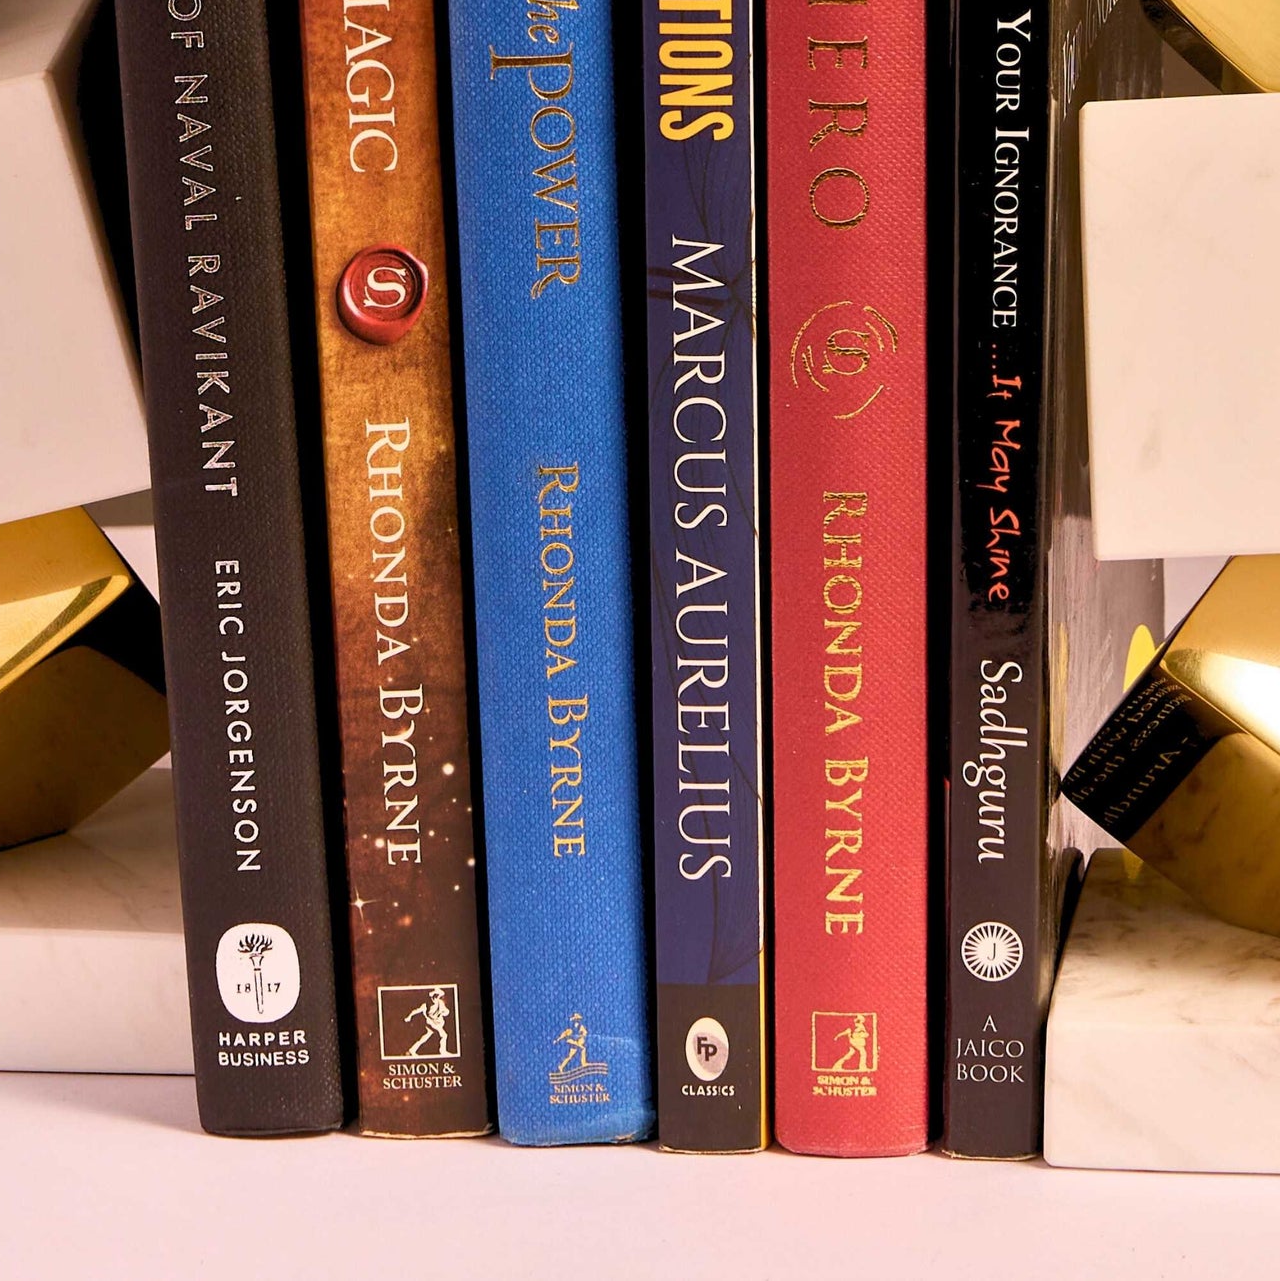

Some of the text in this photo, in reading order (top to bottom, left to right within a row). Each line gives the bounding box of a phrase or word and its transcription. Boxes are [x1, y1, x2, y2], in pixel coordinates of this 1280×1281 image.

[994, 8, 1032, 114] YOUR
[173, 74, 218, 231] NAVAL
[488, 41, 581, 300] POWER
[992, 126, 1030, 330] IGNORANCE
[187, 253, 238, 497] RAVIKANT
[976, 419, 1021, 494] May
[671, 234, 732, 882] MARCUS AURELIUS
[987, 505, 1021, 603] Shine
[365, 416, 425, 867] RHONDA BYRNE
[537, 461, 589, 859] RHONDA BYRNE
[215, 559, 262, 873] ERIC JORGENSON
[822, 490, 870, 936] RHONDA BYRNE
[962, 659, 1029, 865] Sadhguru
[986, 942, 997, 961] J
[235, 980, 282, 995] 18 17
[982, 1014, 999, 1033] A
[218, 1028, 308, 1049] HARPER
[696, 1035, 718, 1062] FP
[956, 1038, 1025, 1060] JAICO
[218, 1048, 311, 1068] BUSINESS
[388, 1061, 456, 1077] SIMON &
[382, 1073, 463, 1091] SCHUSTER
[816, 1075, 859, 1086] SIMON
[956, 1063, 1025, 1084] BOOK
[549, 1093, 611, 1104] SCHUSTER
[553, 1083, 594, 1094] SIMON
[681, 1084, 736, 1097] CLASSICS
[812, 1085, 878, 1097] SCHUSTER
